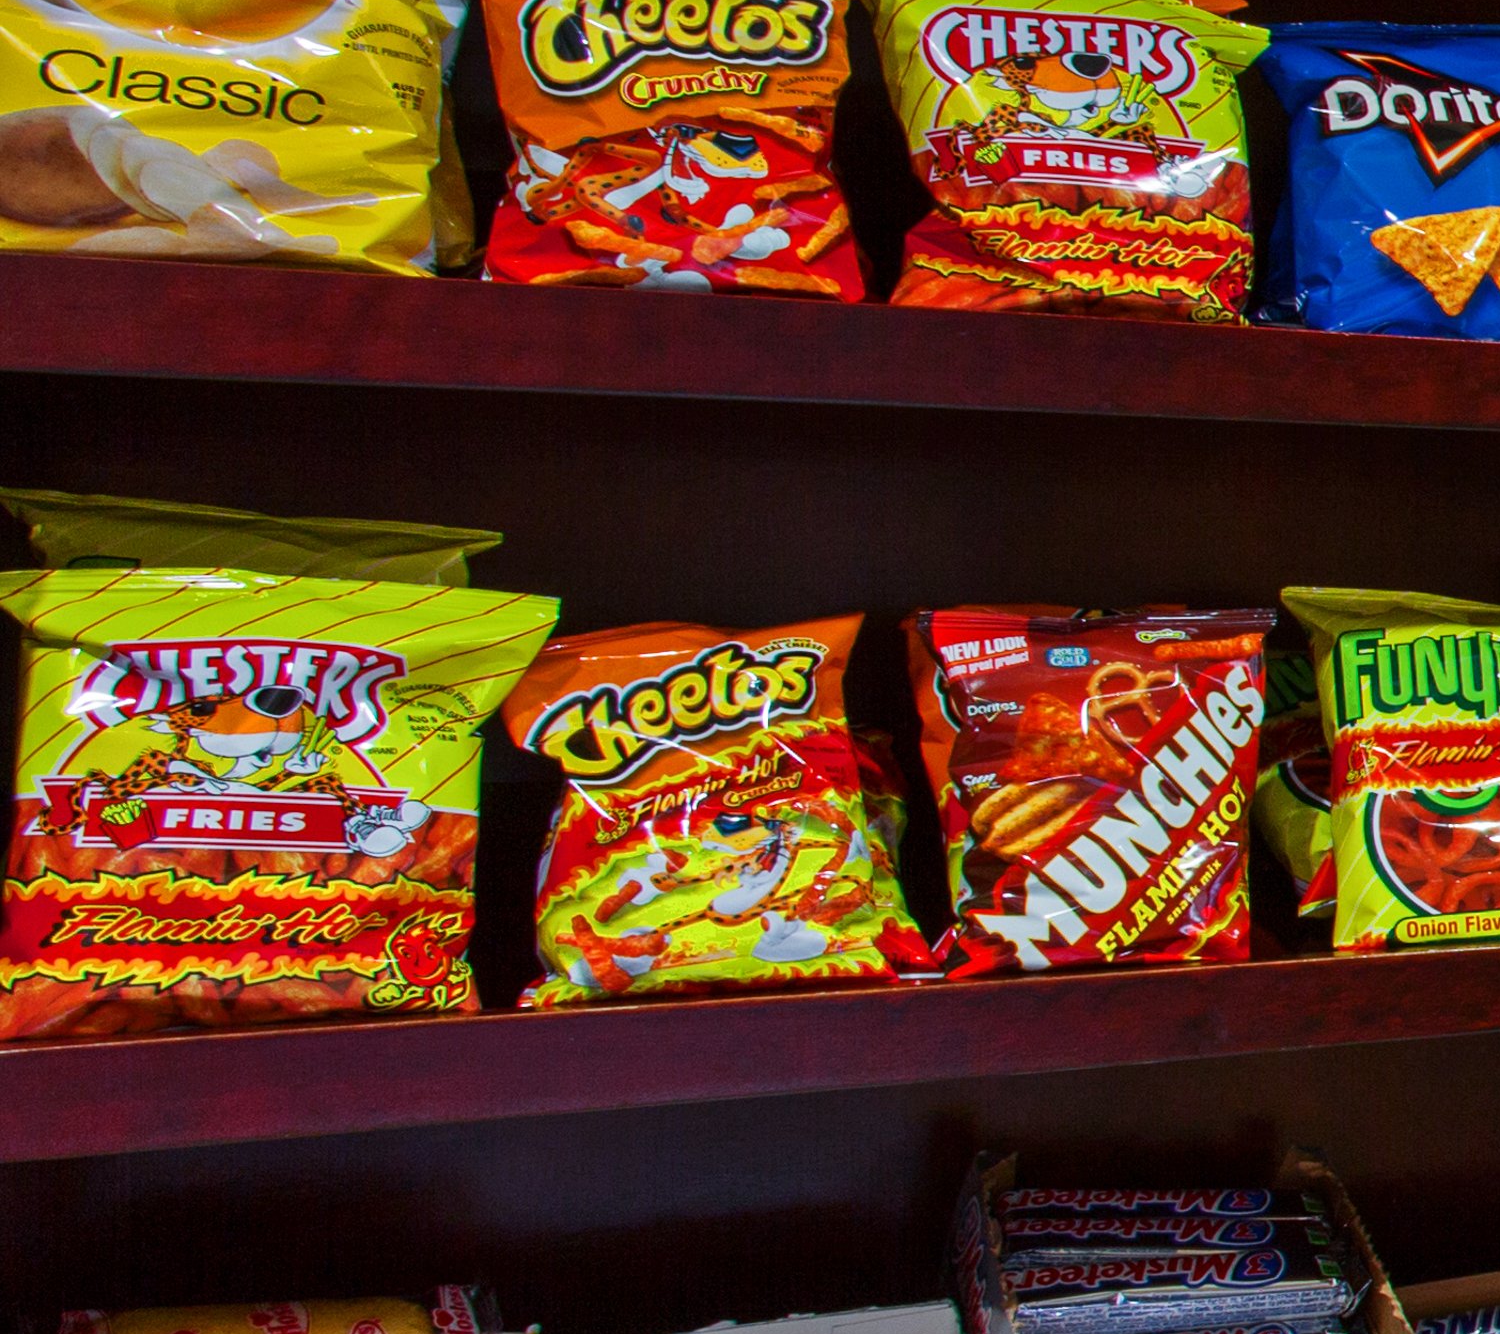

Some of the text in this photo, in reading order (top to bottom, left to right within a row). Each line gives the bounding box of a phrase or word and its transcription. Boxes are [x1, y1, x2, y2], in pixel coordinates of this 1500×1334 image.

[926, 11, 1188, 95] CHESTER'S
[39, 49, 326, 127] Classic
[621, 66, 767, 107] Crunchy
[1022, 148, 1130, 174] FRIES
[972, 228, 1216, 268] Flamin' Hot
[940, 635, 1028, 663] NEW LOOK
[66, 642, 399, 743] CHESTER'S
[967, 701, 1018, 717] Doritos
[541, 648, 813, 777] Cheetos
[1379, 735, 1500, 774] Flamin'
[627, 752, 781, 829] Flamin' Hot
[722, 772, 802, 807] Crunchy
[163, 808, 308, 831] FRIES
[50, 904, 387, 943] Flamin' Hot
[1405, 916, 1460, 939] Onion
